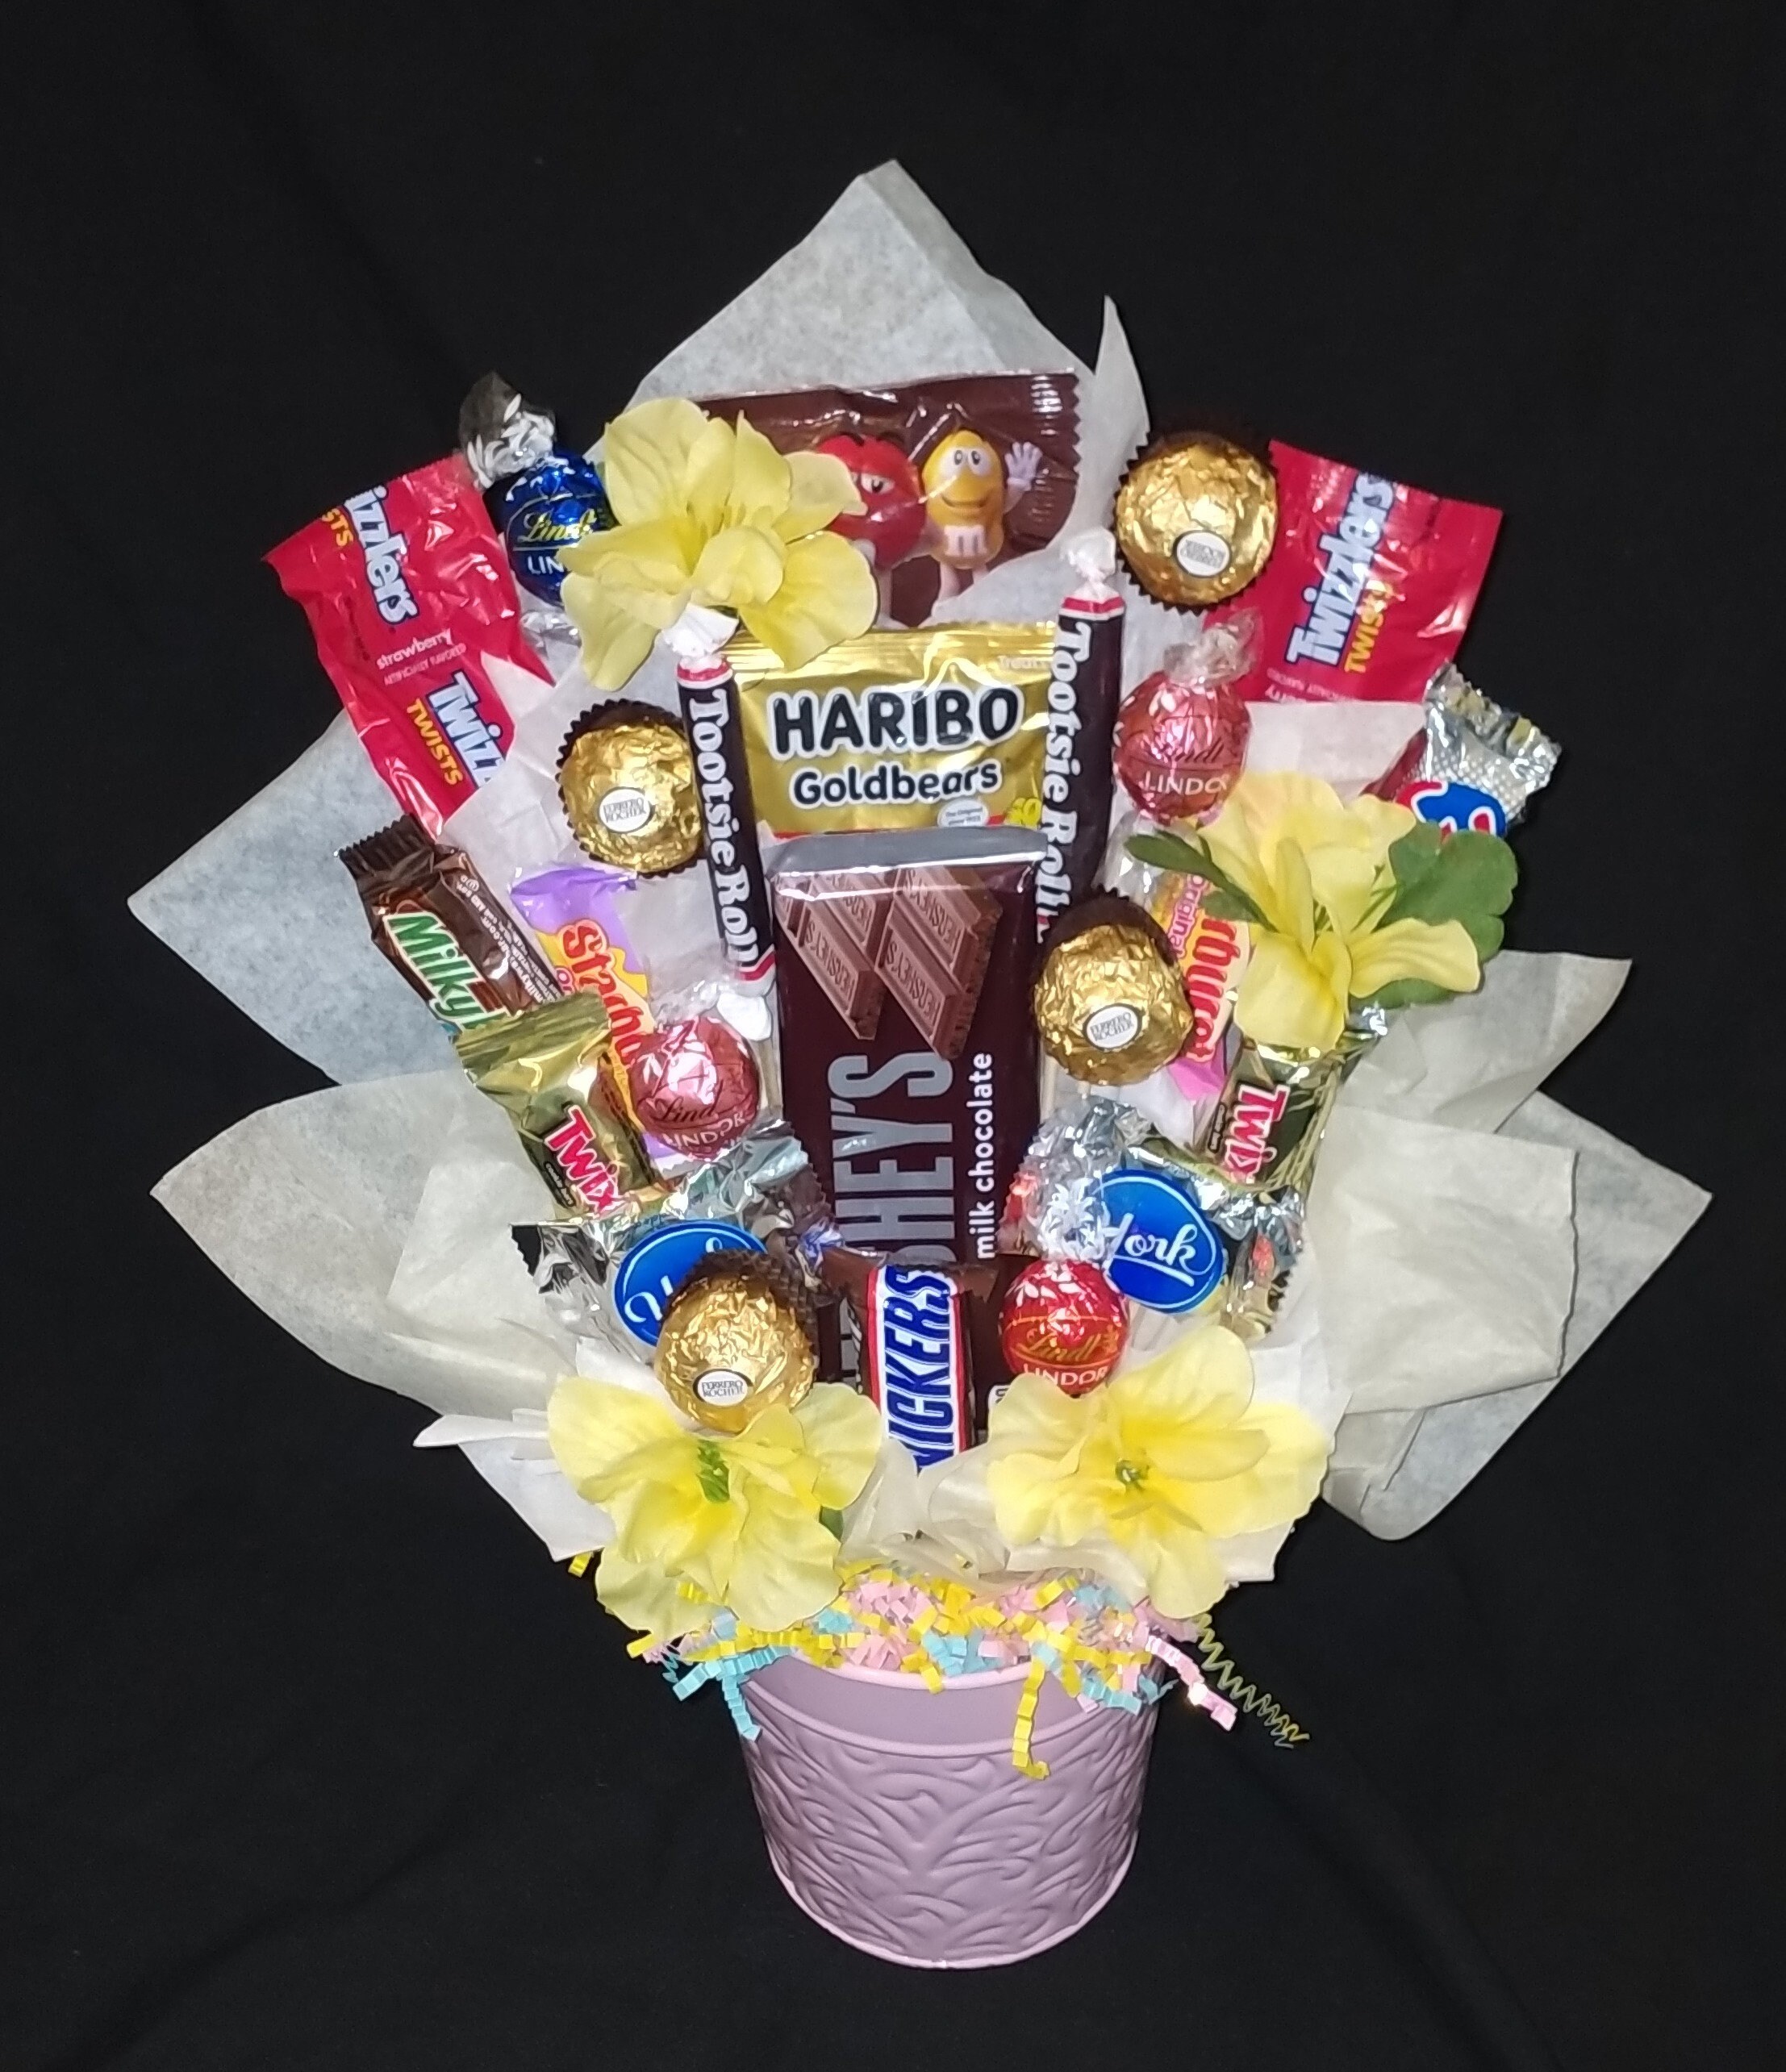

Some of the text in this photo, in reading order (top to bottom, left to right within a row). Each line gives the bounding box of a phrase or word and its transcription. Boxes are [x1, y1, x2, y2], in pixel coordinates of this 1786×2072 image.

[322, 508, 354, 547] STS
[344, 485, 419, 623] izzlers
[528, 556, 564, 574] LIN
[1287, 471, 1394, 666] Twizzlers
[377, 628, 453, 670] strawberry
[407, 698, 464, 786] TWISTS
[771, 686, 1020, 757] HARIBO
[1036, 622, 1091, 918] Tootsie Roll
[688, 687, 759, 967] Tootsie Roll
[793, 762, 999, 805] Goldbears
[388, 915, 483, 1019] Milky
[563, 923, 652, 1065] Starbu
[547, 1108, 621, 1211] Twix
[967, 1053, 994, 1259] milk chocolate
[1224, 1086, 1287, 1182] Twix
